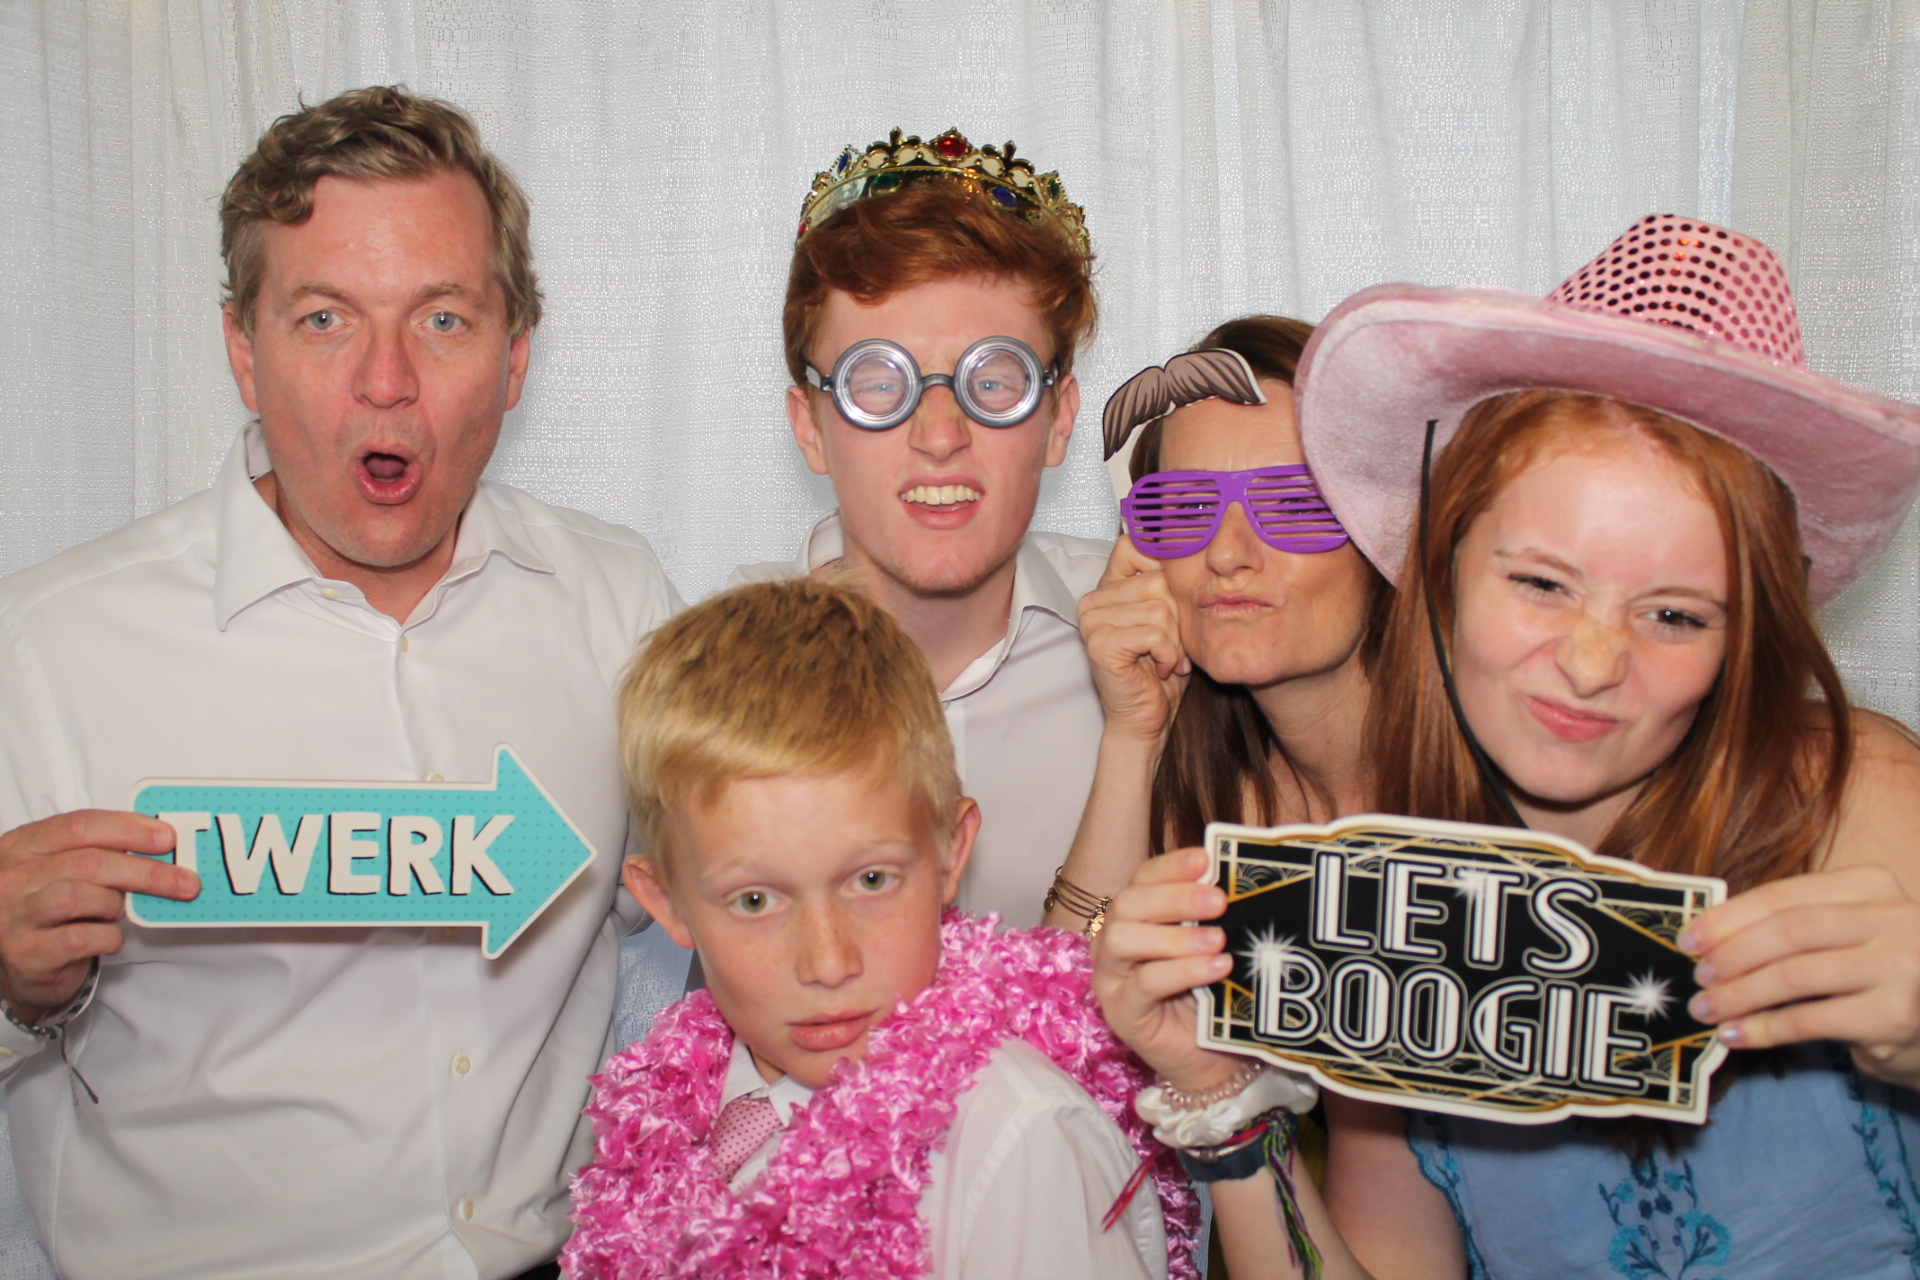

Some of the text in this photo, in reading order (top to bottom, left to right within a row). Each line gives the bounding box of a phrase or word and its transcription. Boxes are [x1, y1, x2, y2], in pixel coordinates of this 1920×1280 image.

[156, 811, 516, 896] TWERK
[1311, 848, 1600, 976] LETS
[1252, 948, 1651, 1091] BOOGIE
